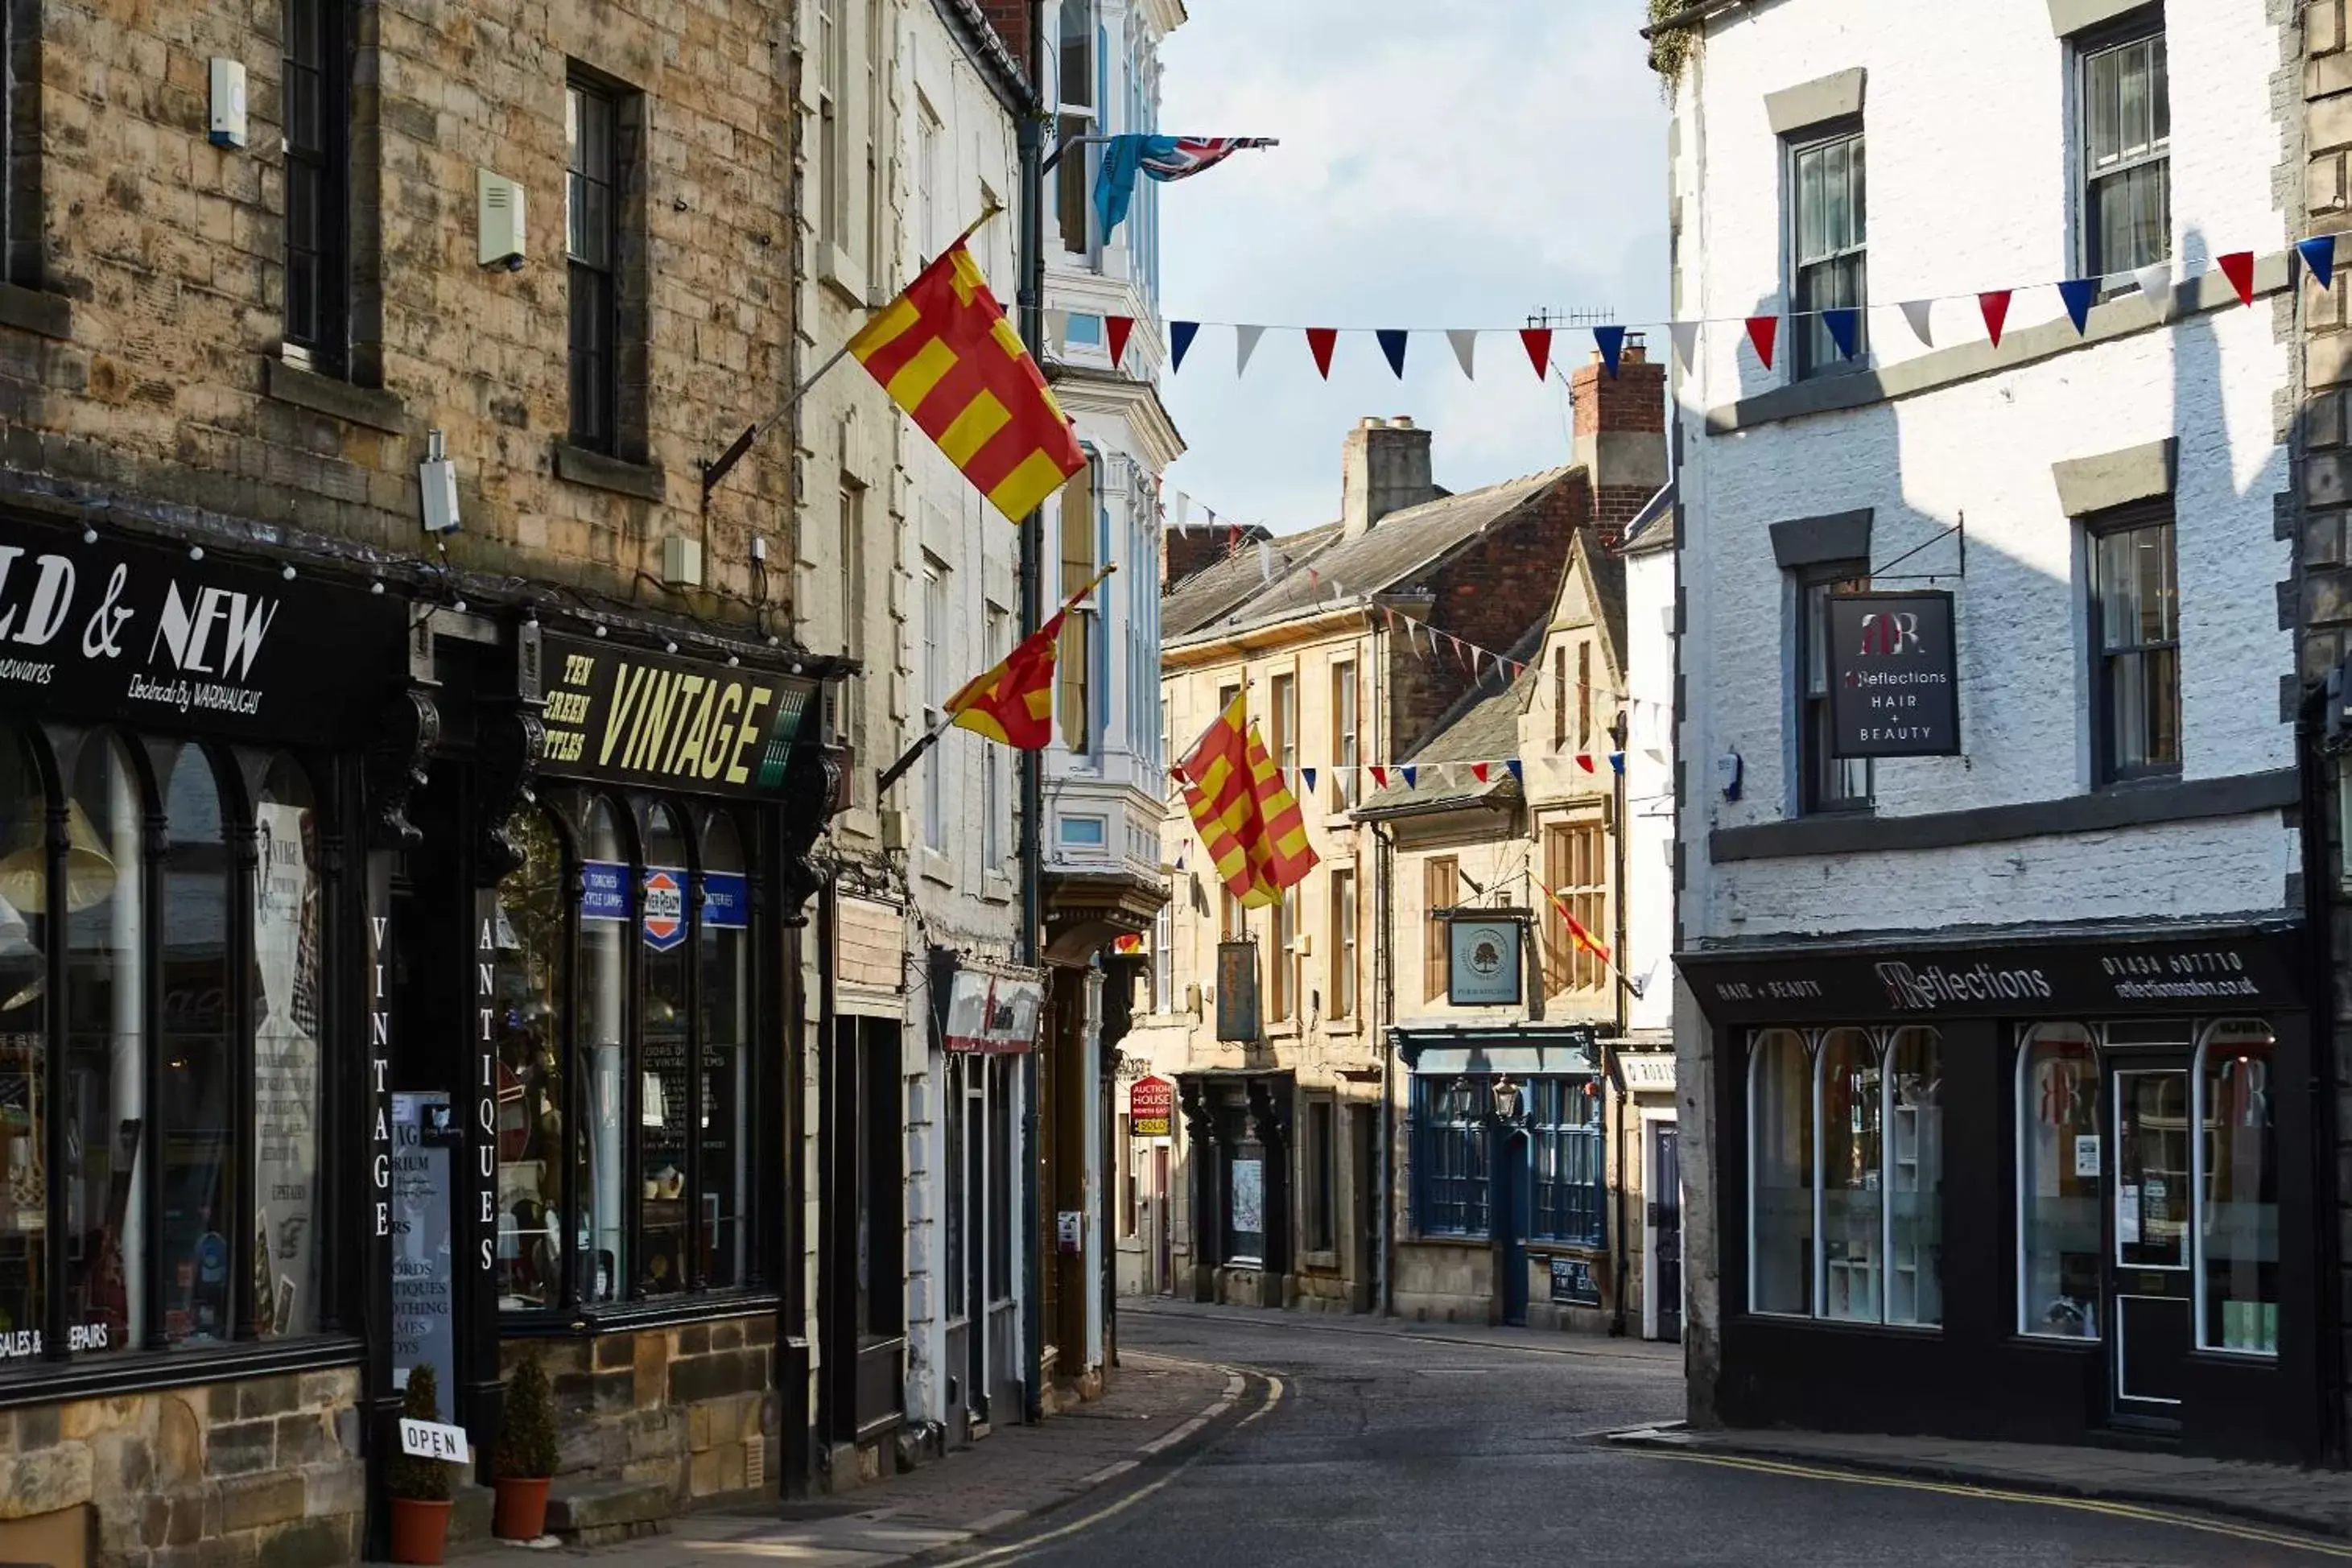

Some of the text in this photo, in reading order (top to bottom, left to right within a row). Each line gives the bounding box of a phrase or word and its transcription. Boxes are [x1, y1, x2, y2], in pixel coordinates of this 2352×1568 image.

[82, 563, 134, 658] &
[148, 578, 279, 683] NEW
[563, 654, 595, 687] TEN
[1845, 670, 1947, 688] Reflections
[542, 690, 592, 724] GREEN
[1871, 695, 1917, 708] HAIR
[598, 662, 773, 784] VINTAGE
[1860, 726, 1931, 741] BEAUTY
[1715, 981, 1754, 1001] HAIR
[1874, 960, 2053, 1010] Reflections
[371, 916, 390, 1237] VINTAGE
[1133, 1084, 1170, 1095] AUCTION
[479, 917, 495, 1270] ANTIQUES
[1133, 1094, 1170, 1105] HOUSE
[1141, 1120, 1167, 1131] SOLD
[33, 1330, 43, 1354] &
[408, 1426, 456, 1455] OPEN
